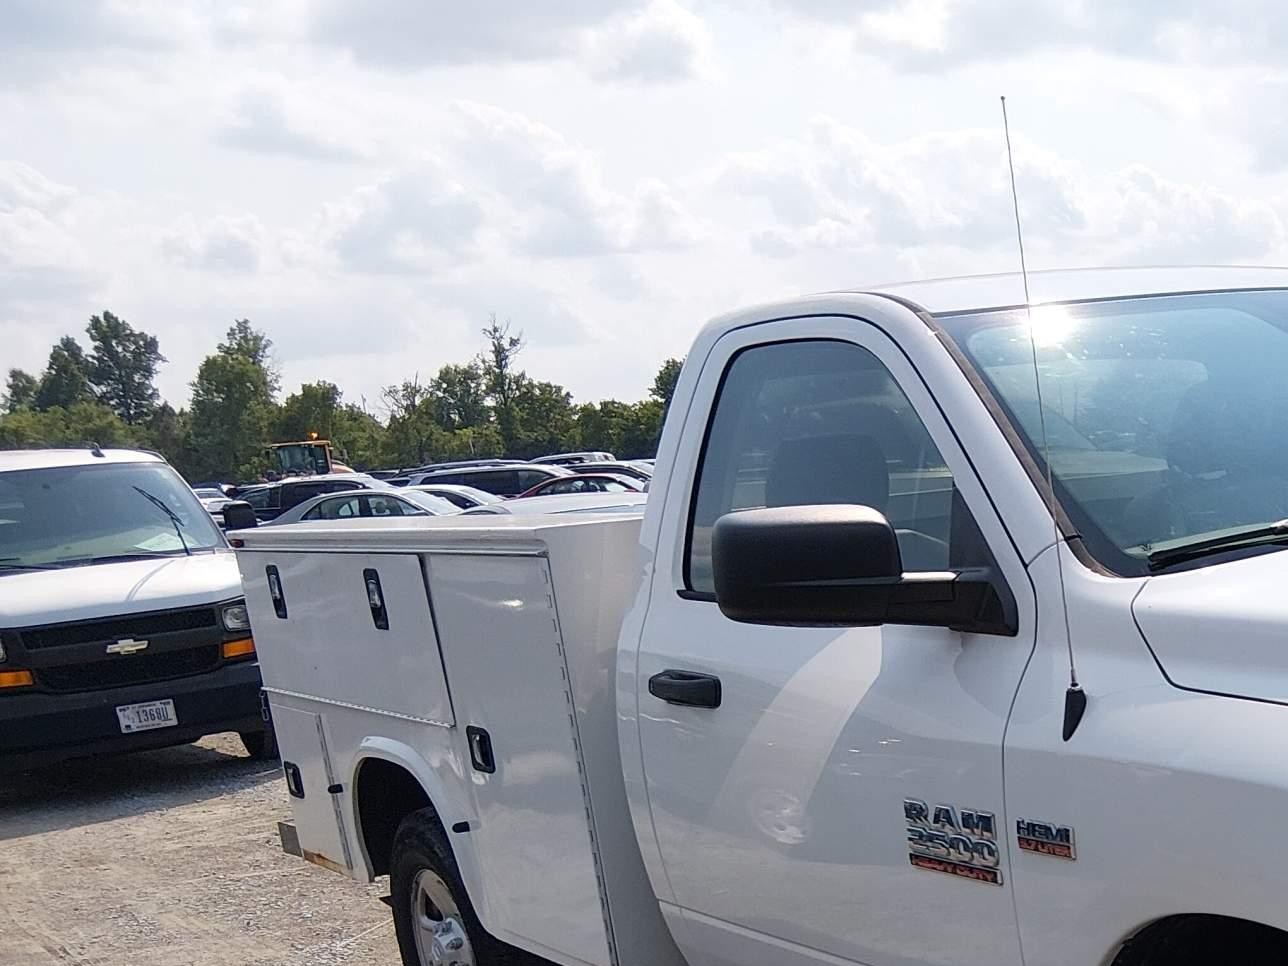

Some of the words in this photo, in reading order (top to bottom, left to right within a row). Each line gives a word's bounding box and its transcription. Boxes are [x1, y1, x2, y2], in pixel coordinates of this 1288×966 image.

[903, 797, 996, 839] RAM
[1016, 818, 1072, 843] HEMI
[905, 826, 1000, 867] 3500
[956, 866, 994, 883] DUTY
